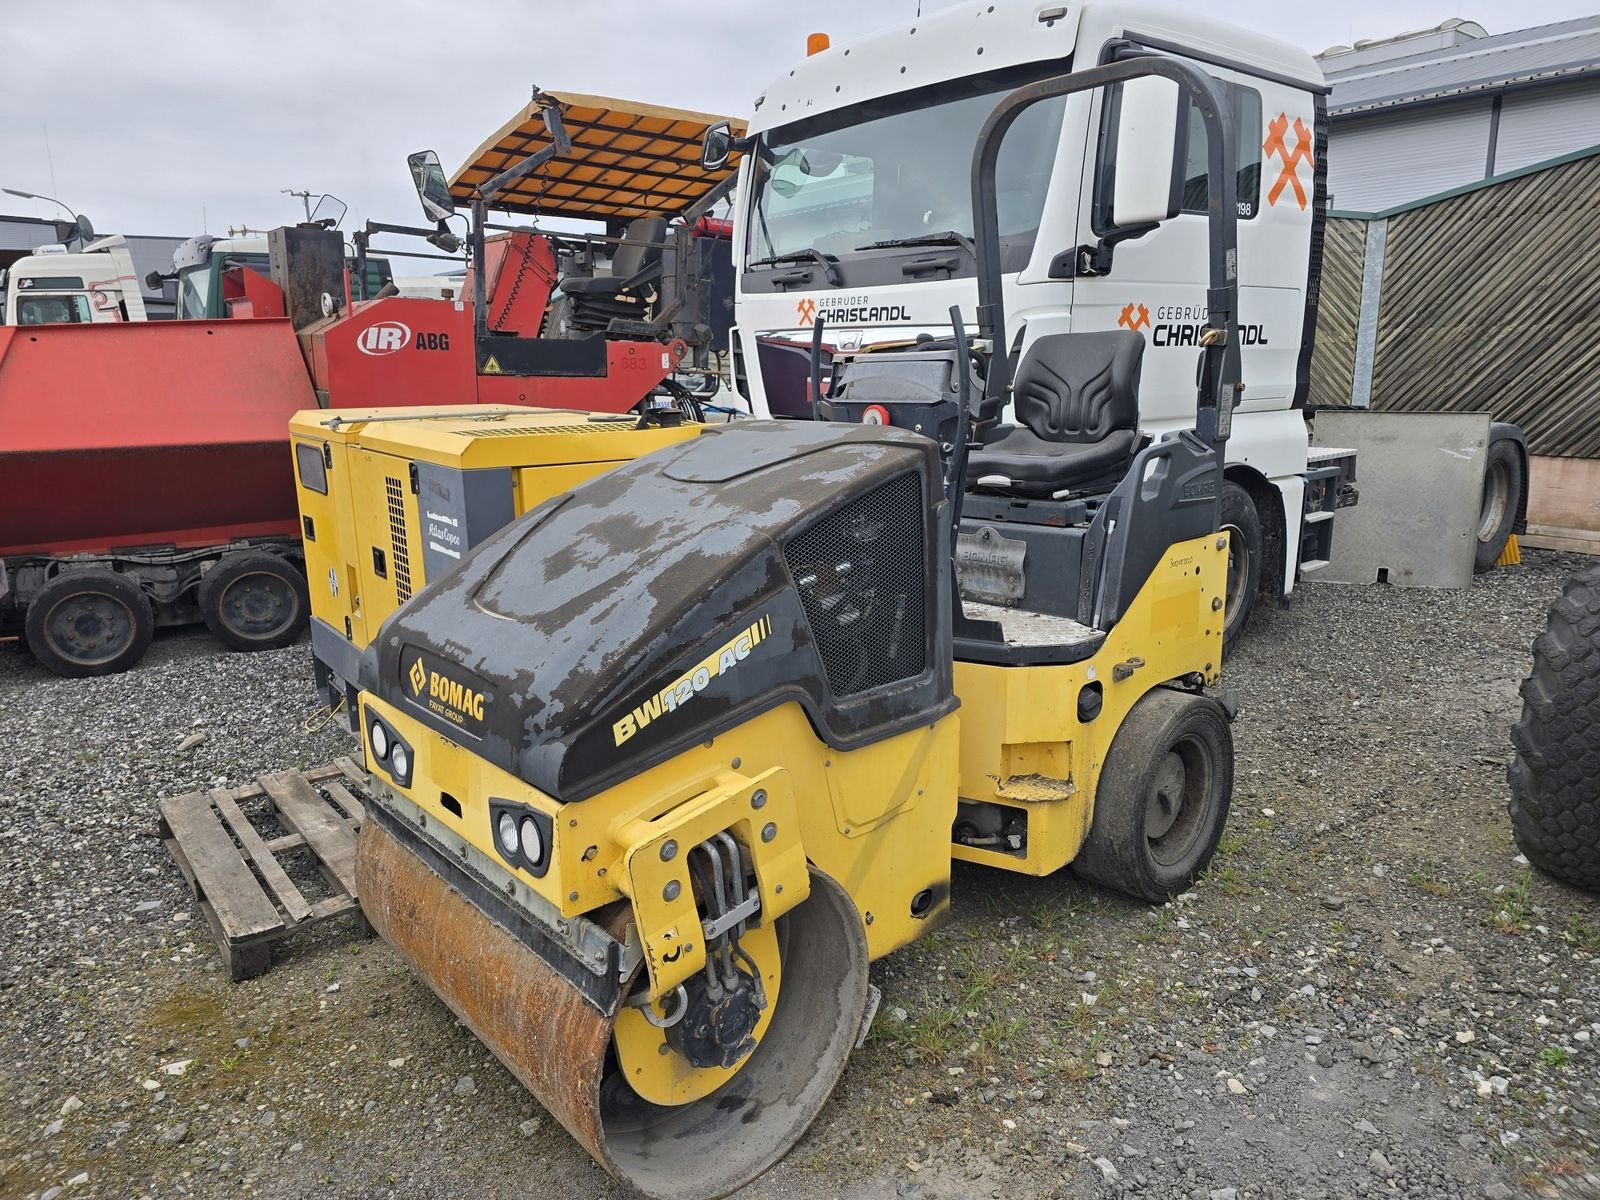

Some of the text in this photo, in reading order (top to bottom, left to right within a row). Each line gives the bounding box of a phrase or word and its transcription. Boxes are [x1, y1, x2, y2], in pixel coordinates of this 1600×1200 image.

[817, 305, 912, 323] CHRISTANDL
[1157, 304, 1208, 320] GEBRÜD
[366, 327, 450, 351] IR ABG
[622, 357, 646, 370] 683
[428, 523, 461, 546] Atlas Copco
[718, 634, 751, 677] AC
[429, 671, 485, 721] BOMAG
[429, 700, 464, 724] FAYAT GROUP
